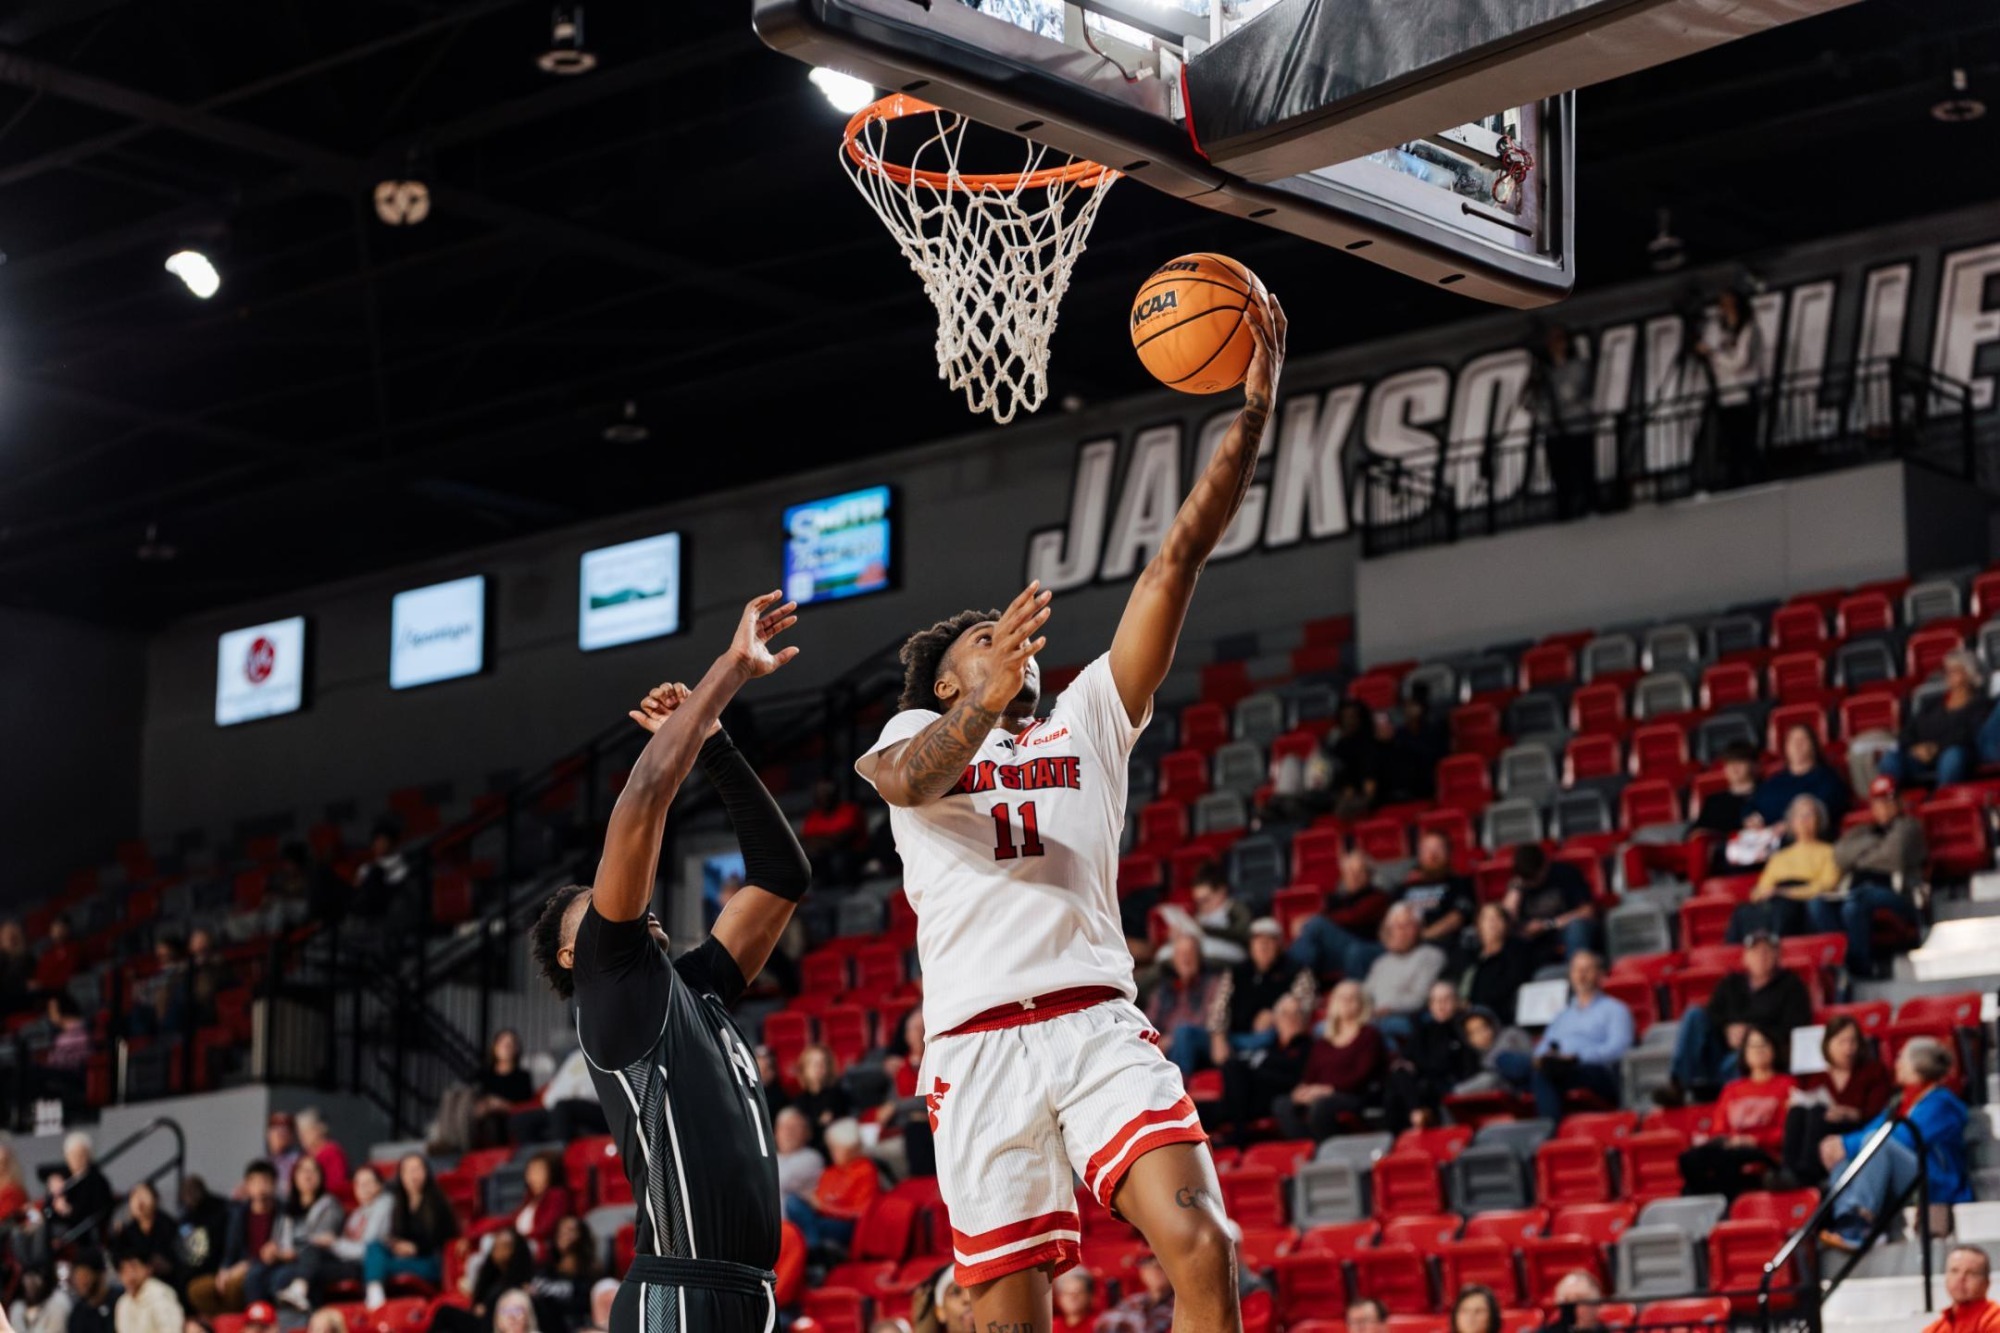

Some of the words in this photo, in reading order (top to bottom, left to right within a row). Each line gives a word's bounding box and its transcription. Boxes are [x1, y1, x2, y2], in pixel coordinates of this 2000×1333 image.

[1133, 289, 1178, 330] NCAA
[941, 759, 998, 798] AX
[998, 755, 1081, 791] STATE
[990, 800, 1045, 861] 11
